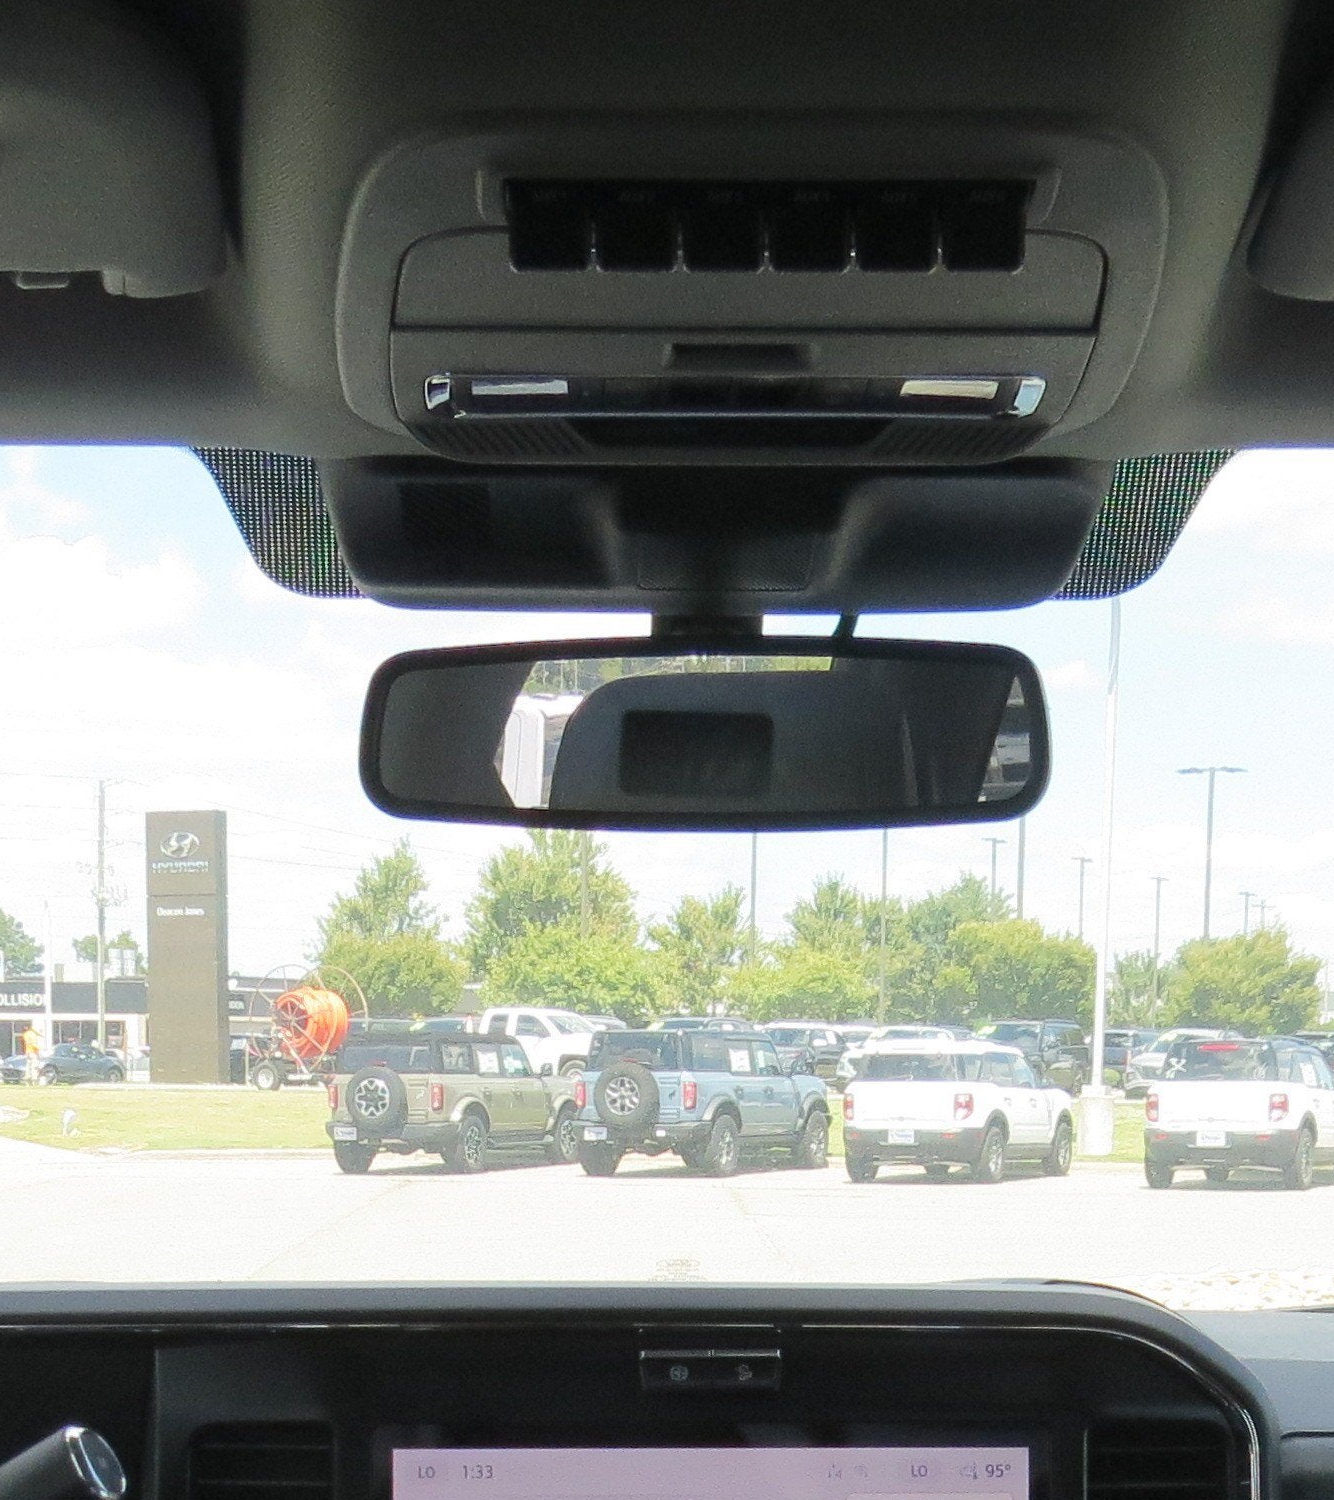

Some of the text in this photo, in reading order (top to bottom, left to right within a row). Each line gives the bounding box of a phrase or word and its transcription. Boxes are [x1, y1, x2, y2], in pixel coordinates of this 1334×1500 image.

[417, 1465, 493, 1479] LO 1:33
[910, 1463, 1011, 1478] LO 95°
